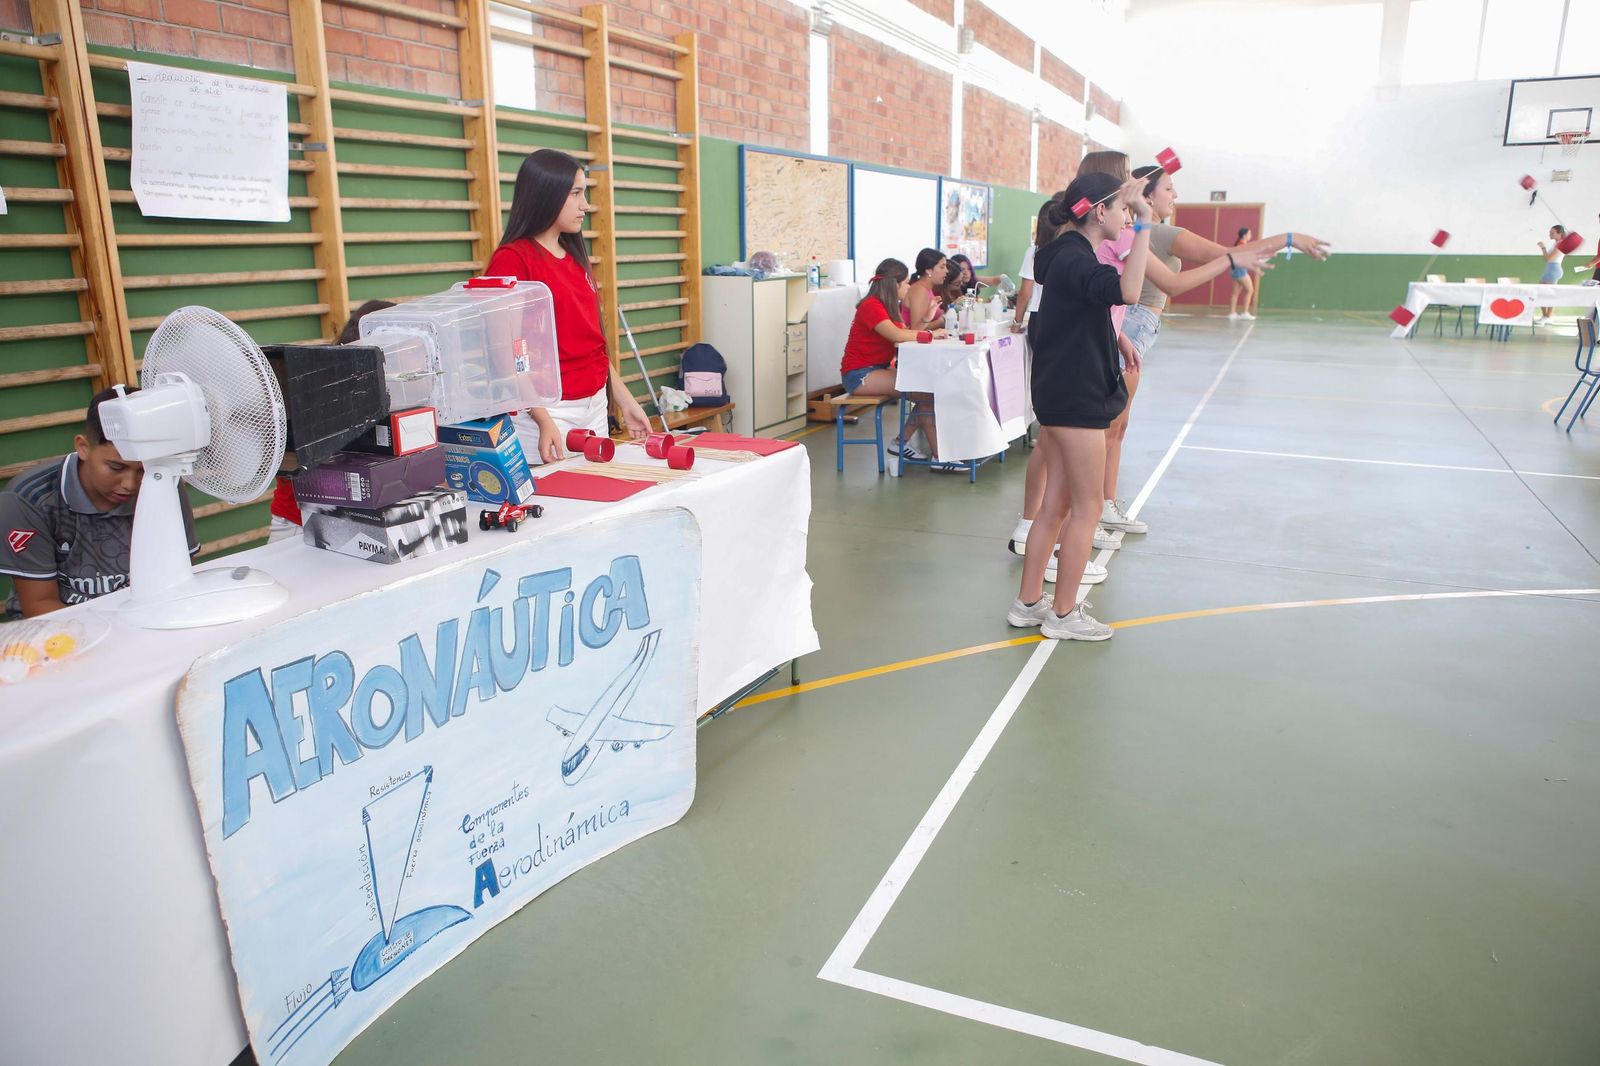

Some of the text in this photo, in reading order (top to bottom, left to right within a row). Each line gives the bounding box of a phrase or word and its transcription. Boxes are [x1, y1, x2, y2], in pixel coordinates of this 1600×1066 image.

[358, 541, 386, 556] PAYMA
[369, 770, 412, 798] Resistencia
[458, 780, 530, 834] Componentes
[469, 820, 505, 849] de la
[467, 837, 505, 865] Fuerza
[473, 799, 631, 909] Aerodinámica
[358, 843, 377, 921] Sustentación
